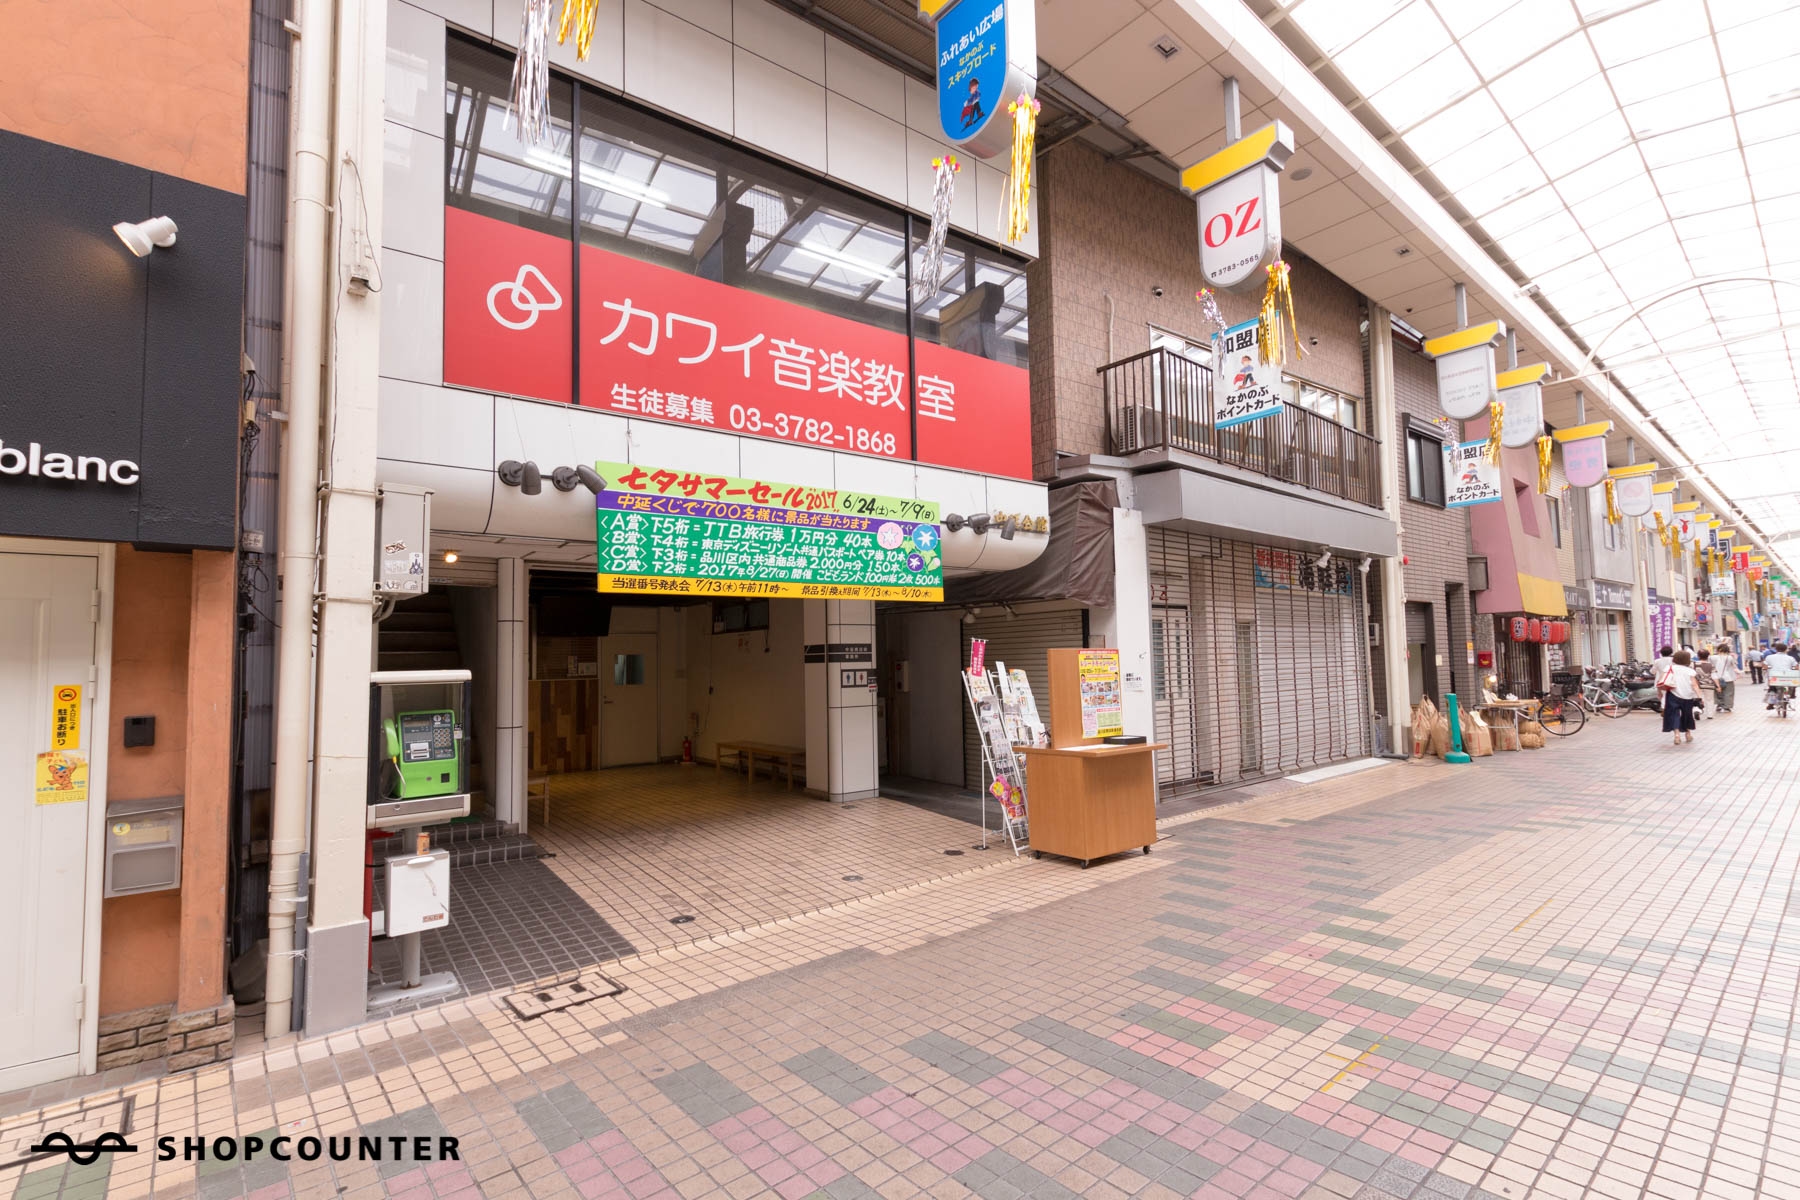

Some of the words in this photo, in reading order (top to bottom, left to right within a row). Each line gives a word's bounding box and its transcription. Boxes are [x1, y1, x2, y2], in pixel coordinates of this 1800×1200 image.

[940, 3, 1004, 67] ふれあい広場
[947, 43, 997, 89] スキップロード
[959, 40, 984, 66] なかのぶ
[1204, 196, 1261, 248] OZ
[1218, 254, 1259, 275] 3783-0565
[599, 297, 957, 422] カワイ音楽教室
[1216, 394, 1281, 420] ポイントカード
[1226, 385, 1269, 405] なかのぶ
[610, 383, 715, 424] 生徒募集
[729, 403, 897, 454] 03-3782-1868
[0, 438, 140, 486] blanc
[617, 466, 805, 508] 七夕サマーセール
[1447, 489, 1500, 503] ポイントカード
[1456, 483, 1490, 494] なかのぶ
[617, 494, 871, 530] 中延くじで700名様に景品が当たります
[791, 528, 838, 546] 1万円分
[843, 534, 872, 548] 40本
[791, 568, 813, 580] 開催
[868, 560, 901, 573] 150本
[612, 577, 691, 592] 当選番号発表会
[56, 708, 68, 746] 駐車お断り
